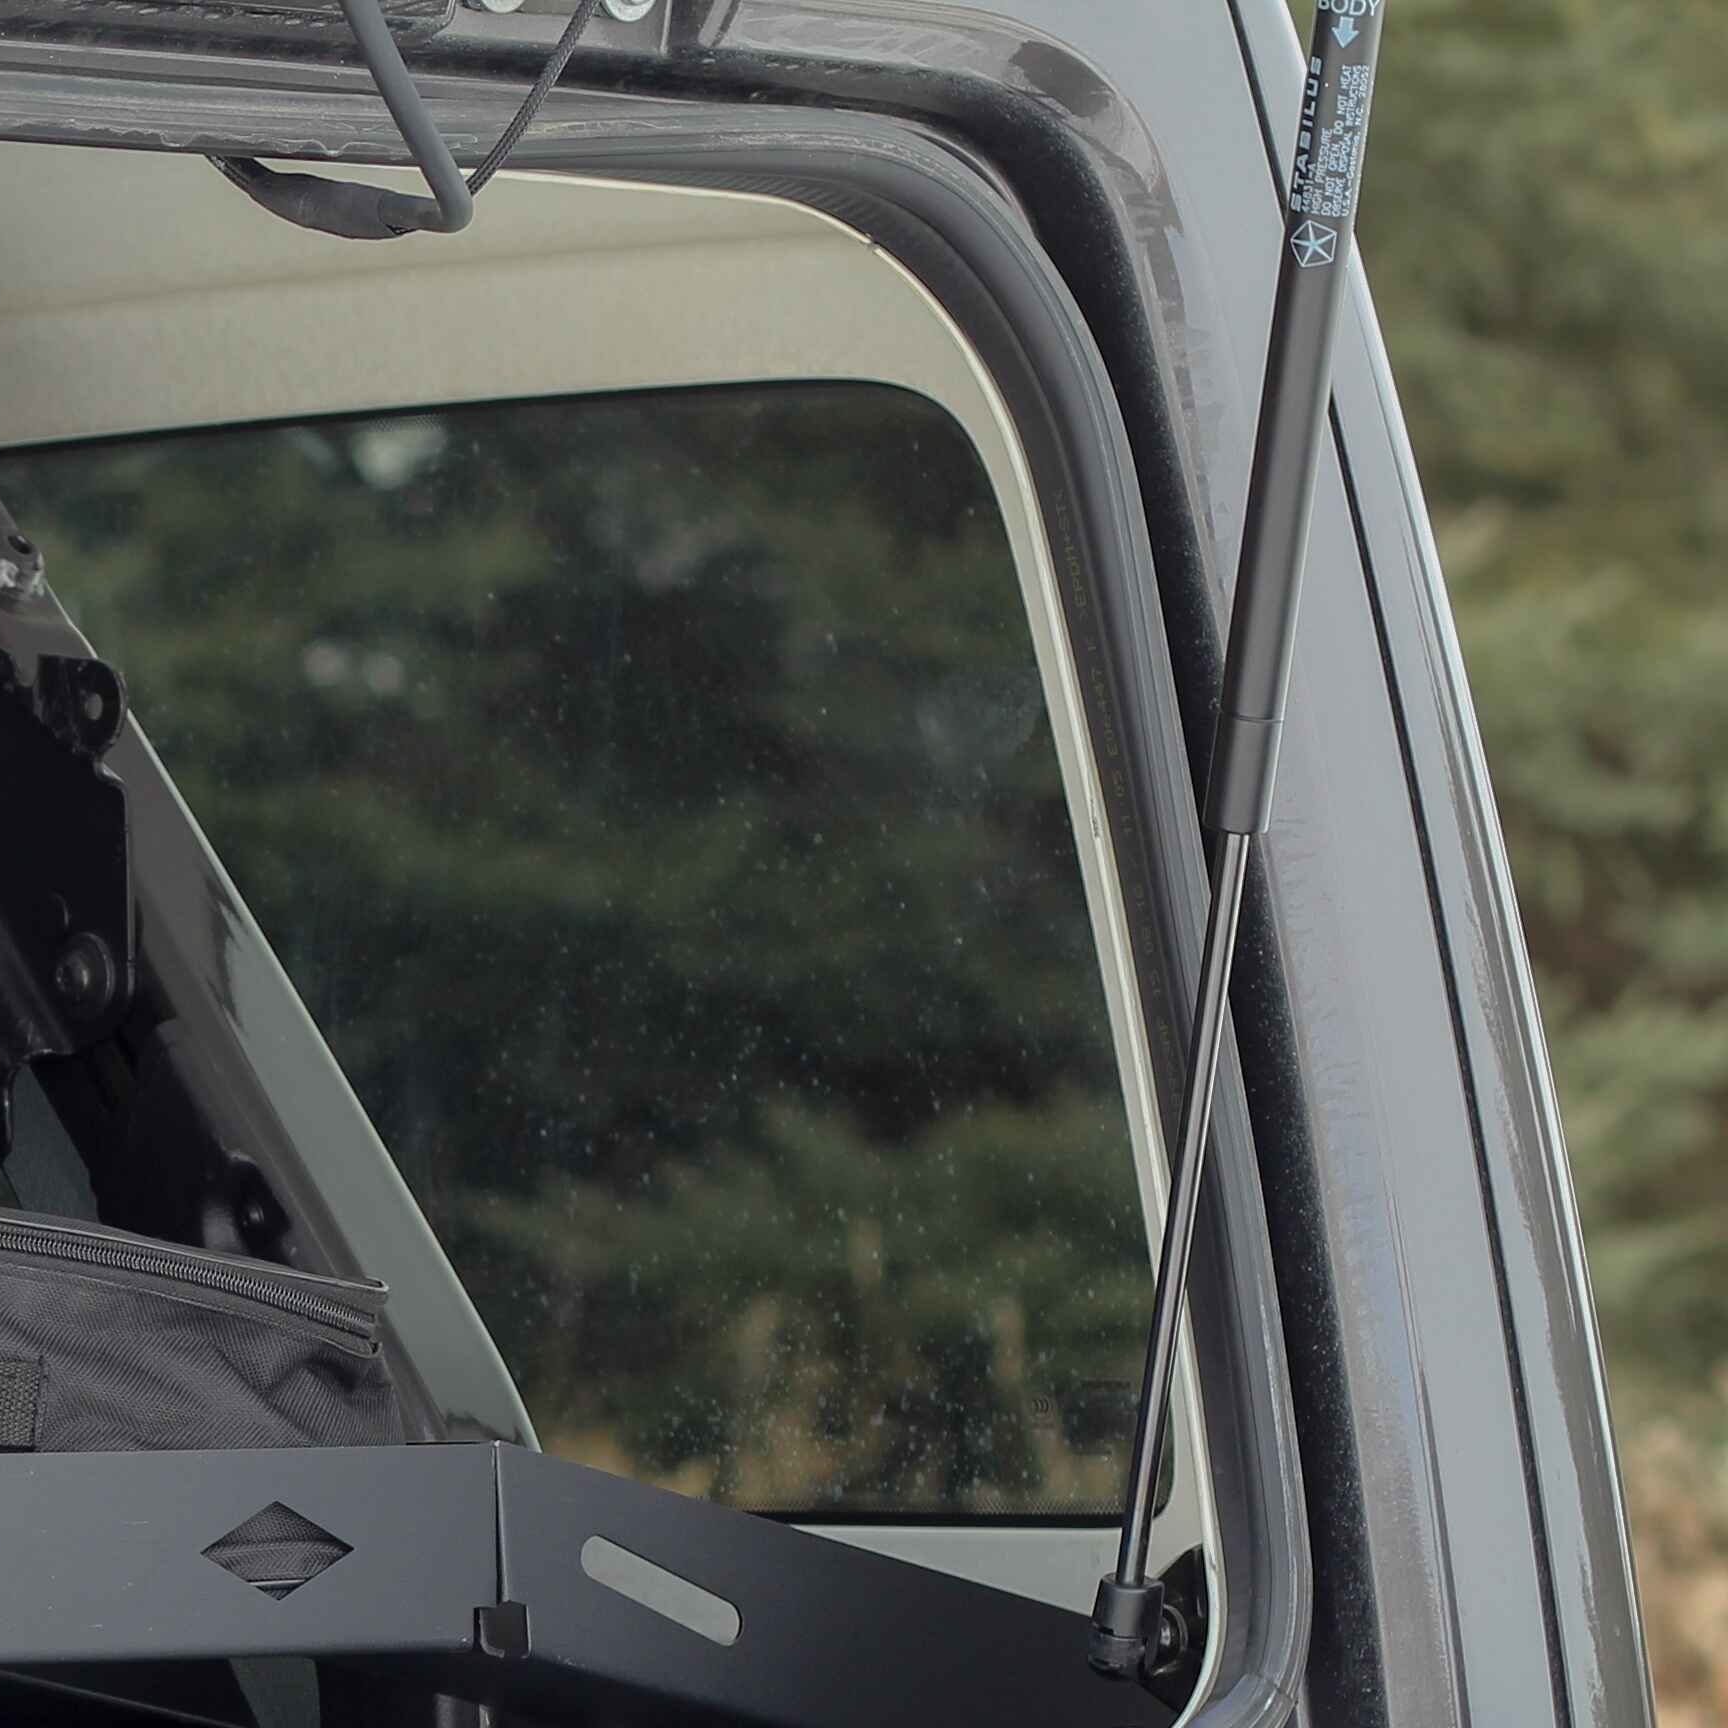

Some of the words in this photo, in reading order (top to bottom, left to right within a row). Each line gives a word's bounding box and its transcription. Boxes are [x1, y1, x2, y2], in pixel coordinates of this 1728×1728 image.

[1336, 94, 1349, 115] NOT
[1290, 56, 1322, 212] STABILUS
[1333, 120, 1344, 135] DO
[1314, 128, 1333, 183] PRESSURE
[1320, 201, 1332, 216] DO
